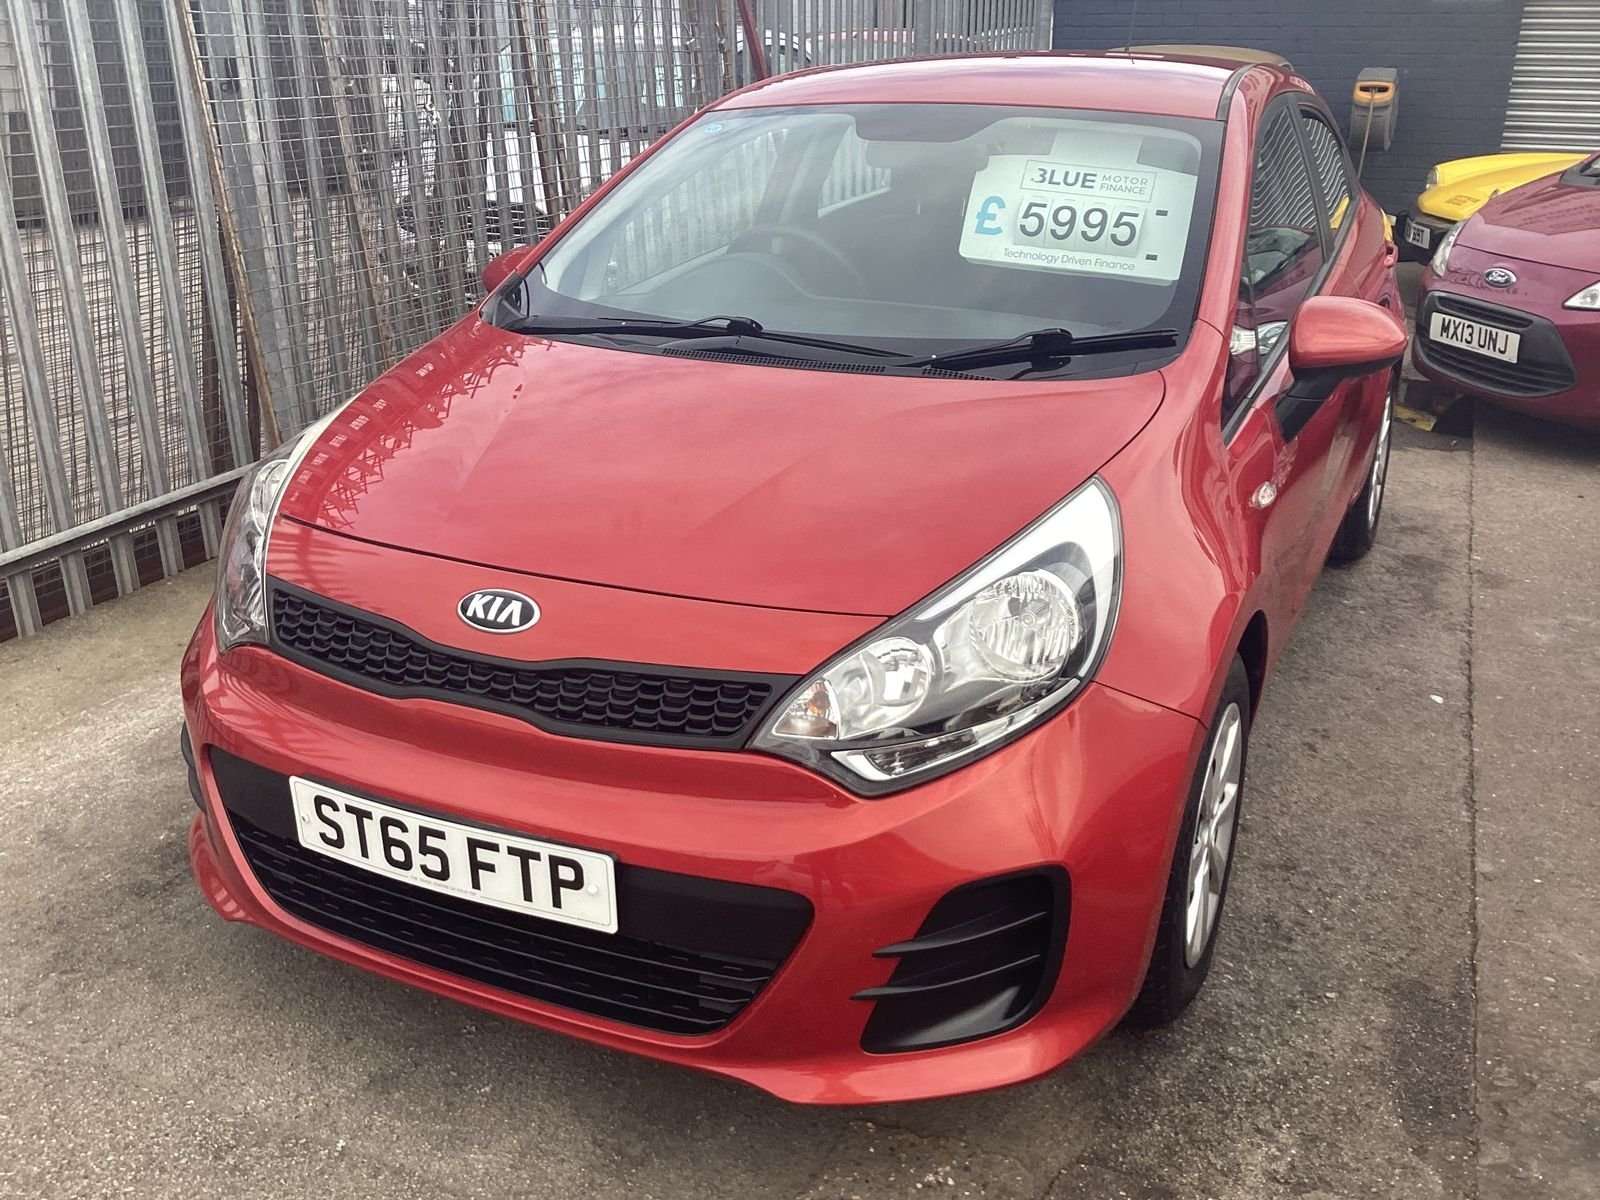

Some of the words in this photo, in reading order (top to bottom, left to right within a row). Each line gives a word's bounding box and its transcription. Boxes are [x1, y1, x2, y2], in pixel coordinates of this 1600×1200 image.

[1100, 182, 1146, 196] FINANCE
[1102, 175, 1149, 186] MOTOR
[975, 195, 1006, 236] £
[1019, 202, 1139, 247] 5995
[1003, 248, 1060, 265] Technology
[1060, 254, 1092, 267] Driven
[1094, 257, 1136, 271] Finance
[1440, 317, 1474, 345] MX13
[1477, 324, 1511, 355] UNJ
[466, 593, 523, 626] KIA
[314, 795, 451, 882] ST65
[466, 837, 586, 909] FTP
